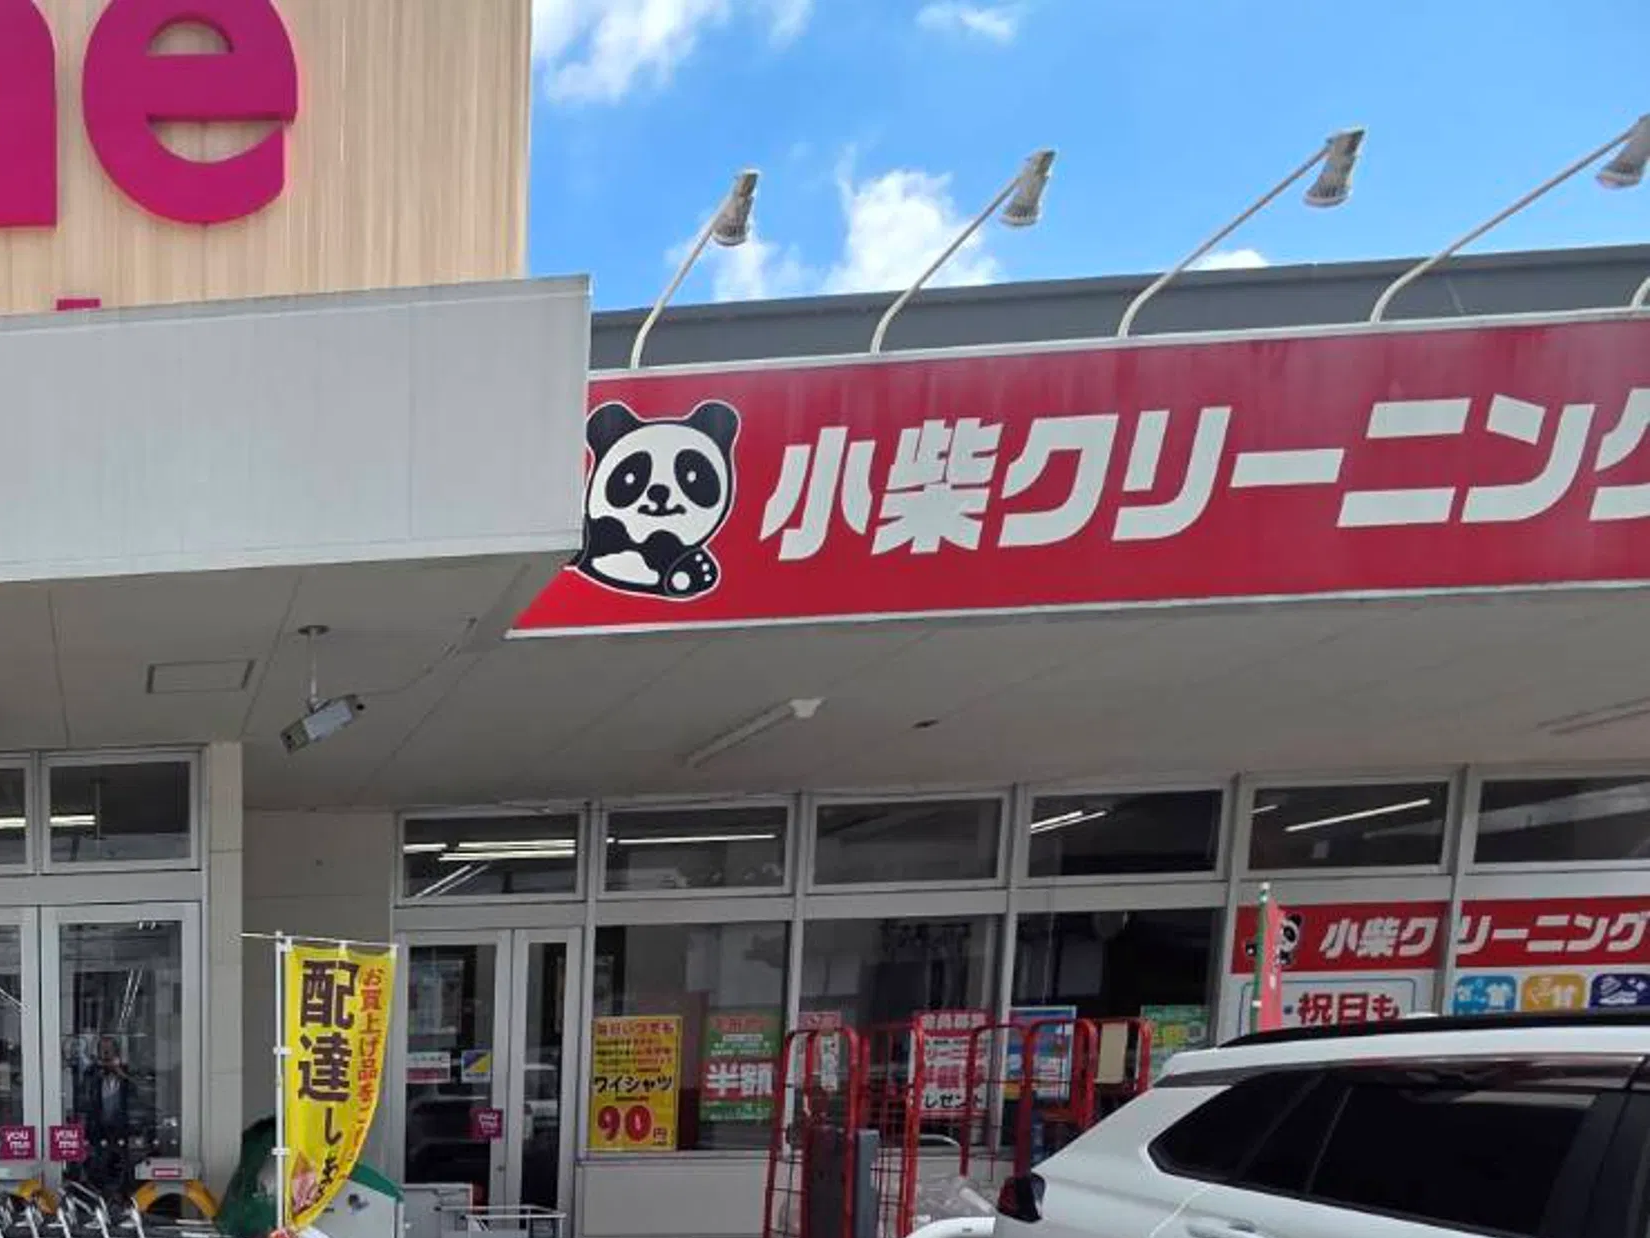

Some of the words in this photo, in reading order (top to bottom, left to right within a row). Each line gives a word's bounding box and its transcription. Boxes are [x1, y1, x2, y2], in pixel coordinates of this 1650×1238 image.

[1297, 991, 1400, 1025] 祝日も
[594, 1076, 672, 1095] ワイシャツ
[706, 1063, 773, 1097] 半額
